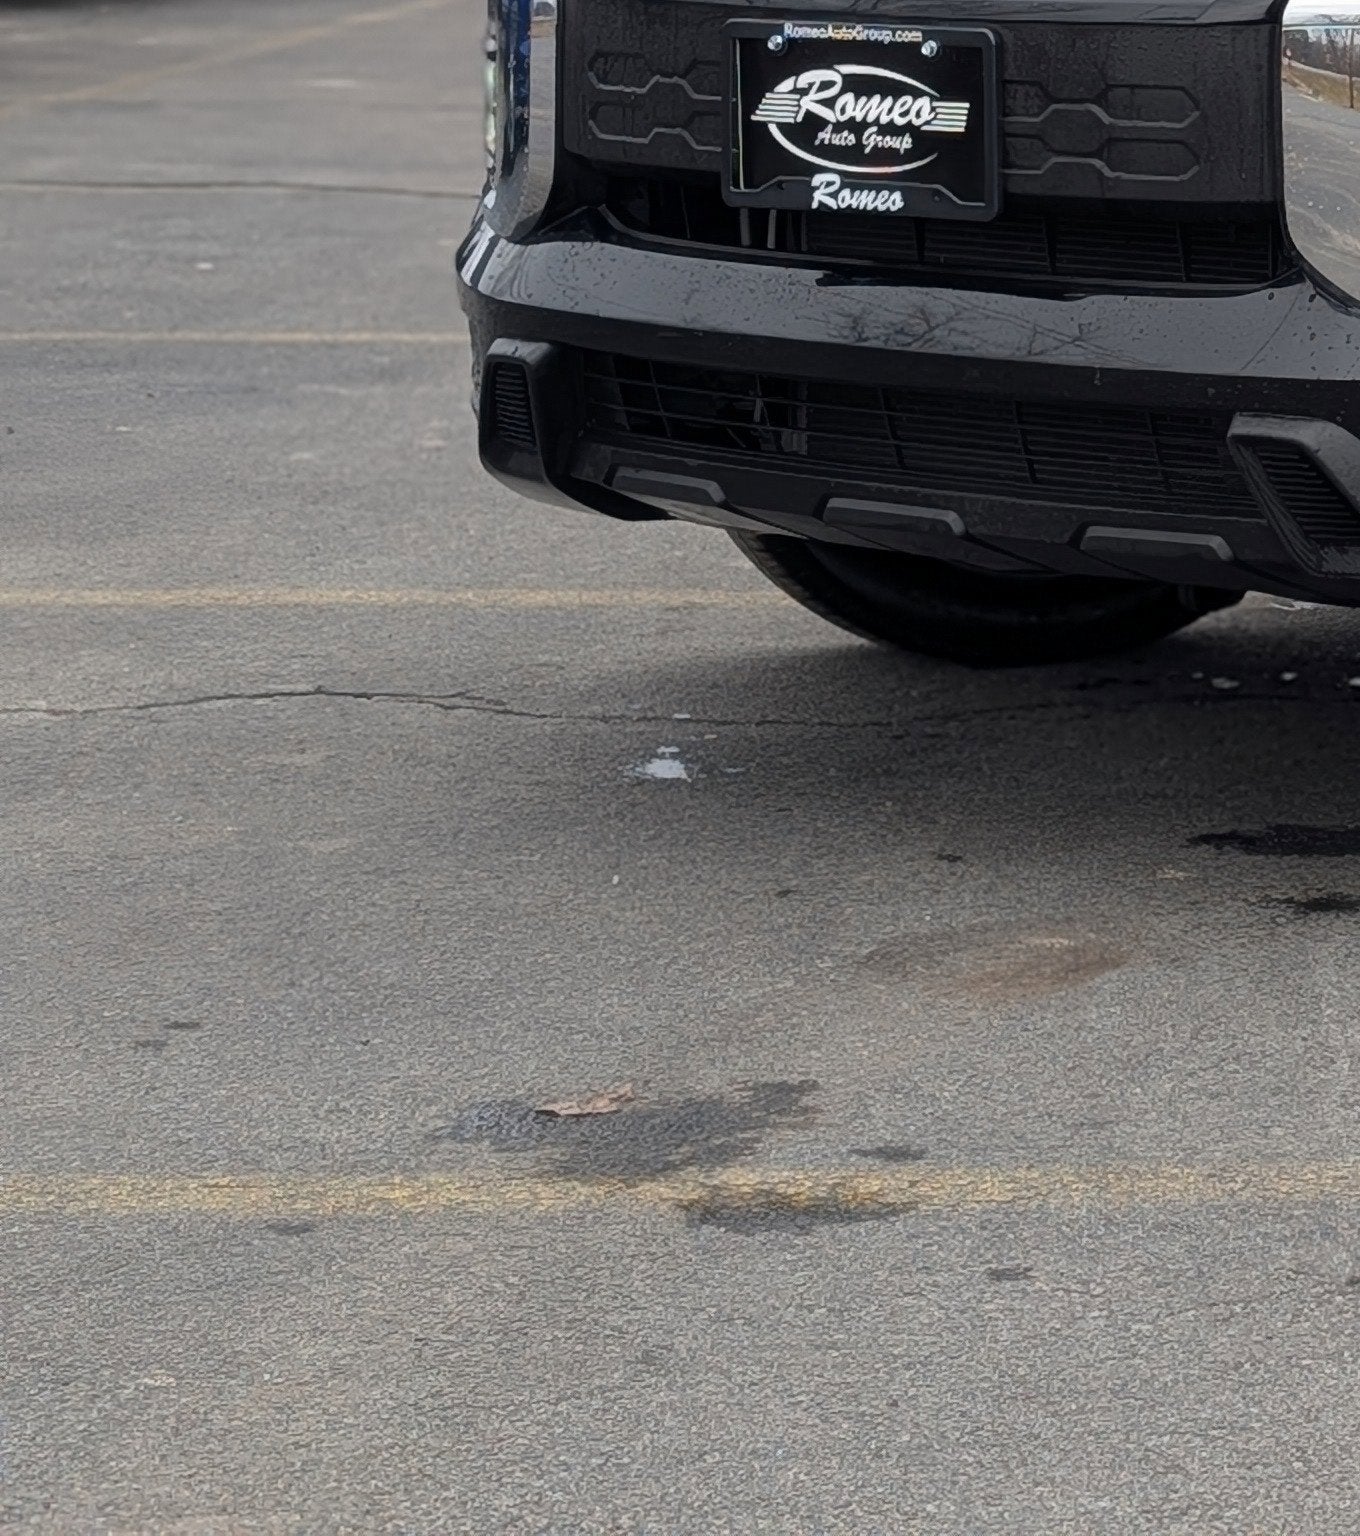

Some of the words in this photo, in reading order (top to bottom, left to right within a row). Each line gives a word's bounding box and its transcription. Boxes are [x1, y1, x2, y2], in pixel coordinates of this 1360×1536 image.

[783, 22, 923, 43] RomeoAutoGroup.com
[796, 68, 937, 126] Romeo
[814, 124, 856, 146] Auto
[862, 126, 913, 154] Group
[811, 172, 905, 212] Romeo
